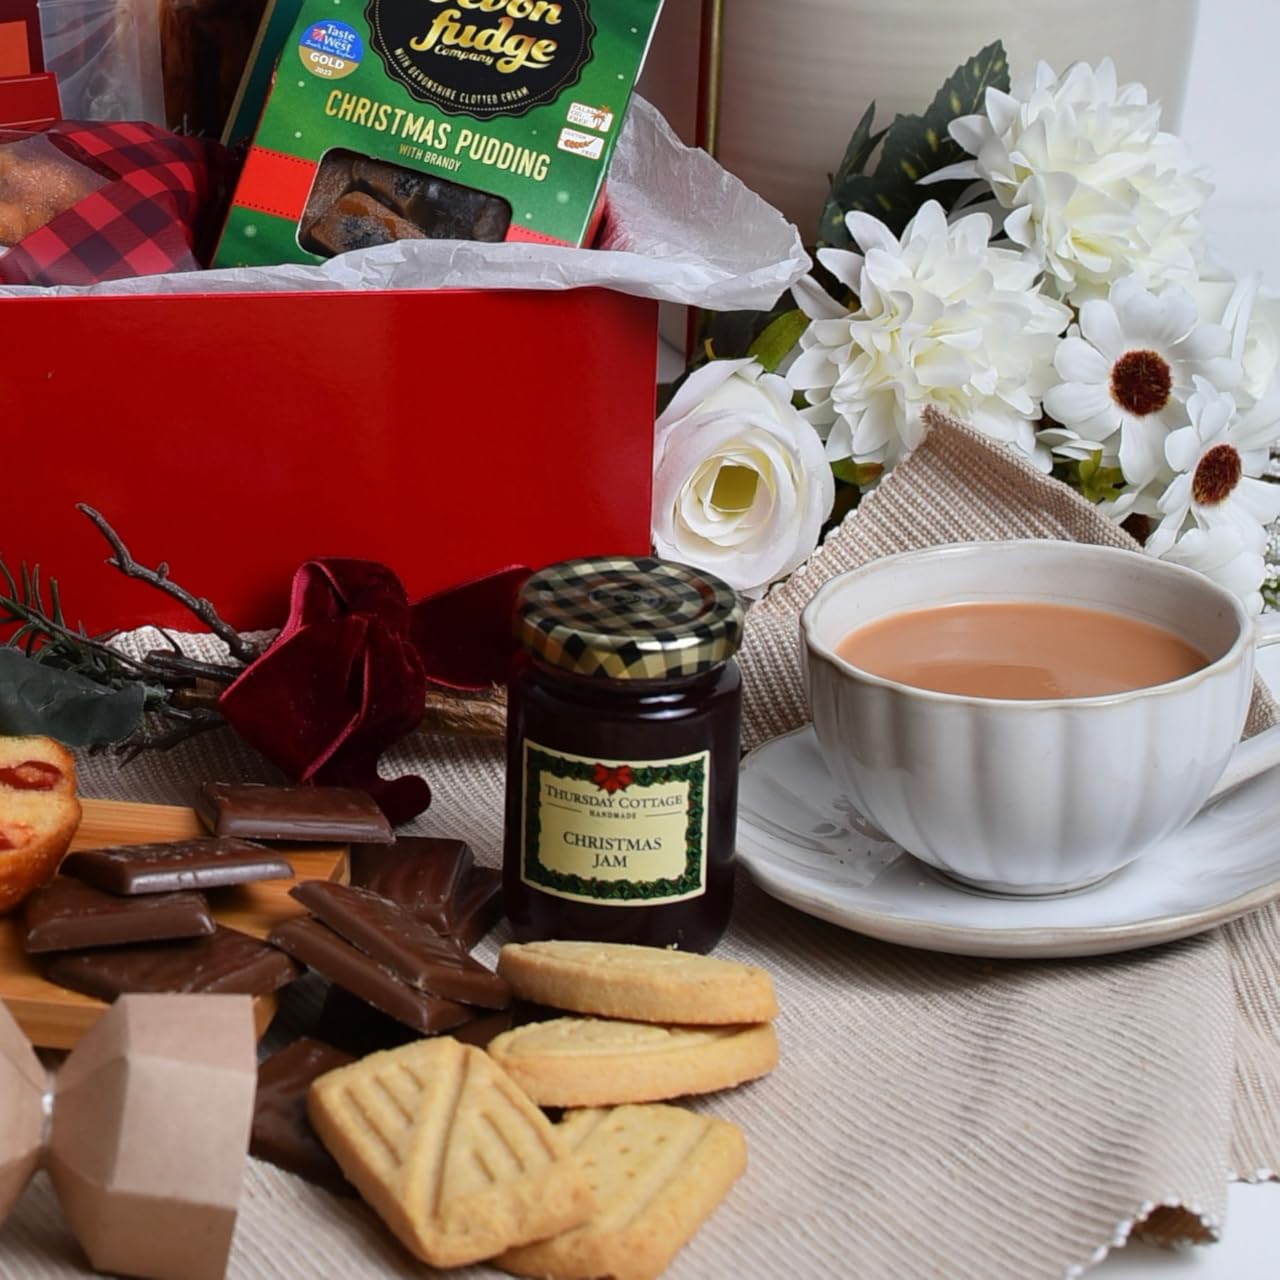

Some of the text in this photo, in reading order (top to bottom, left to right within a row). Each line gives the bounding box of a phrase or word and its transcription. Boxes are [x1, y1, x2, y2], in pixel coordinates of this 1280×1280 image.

[324, 34, 352, 53] West
[326, 23, 356, 42] Taste
[309, 51, 346, 70] GOLD
[433, 43, 495, 66] Company
[393, 47, 530, 105] WITH DEVONSHIRE CLOTTED CREAM
[324, 88, 552, 183] CHRISTMAS PUDDING
[398, 143, 463, 173] WITH BRANDY
[545, 783, 683, 809] THURSDAY COTTAGE
[589, 810, 637, 819] HANDMADE
[562, 830, 663, 852] CHRISTMAS
[592, 853, 628, 869] JAM
